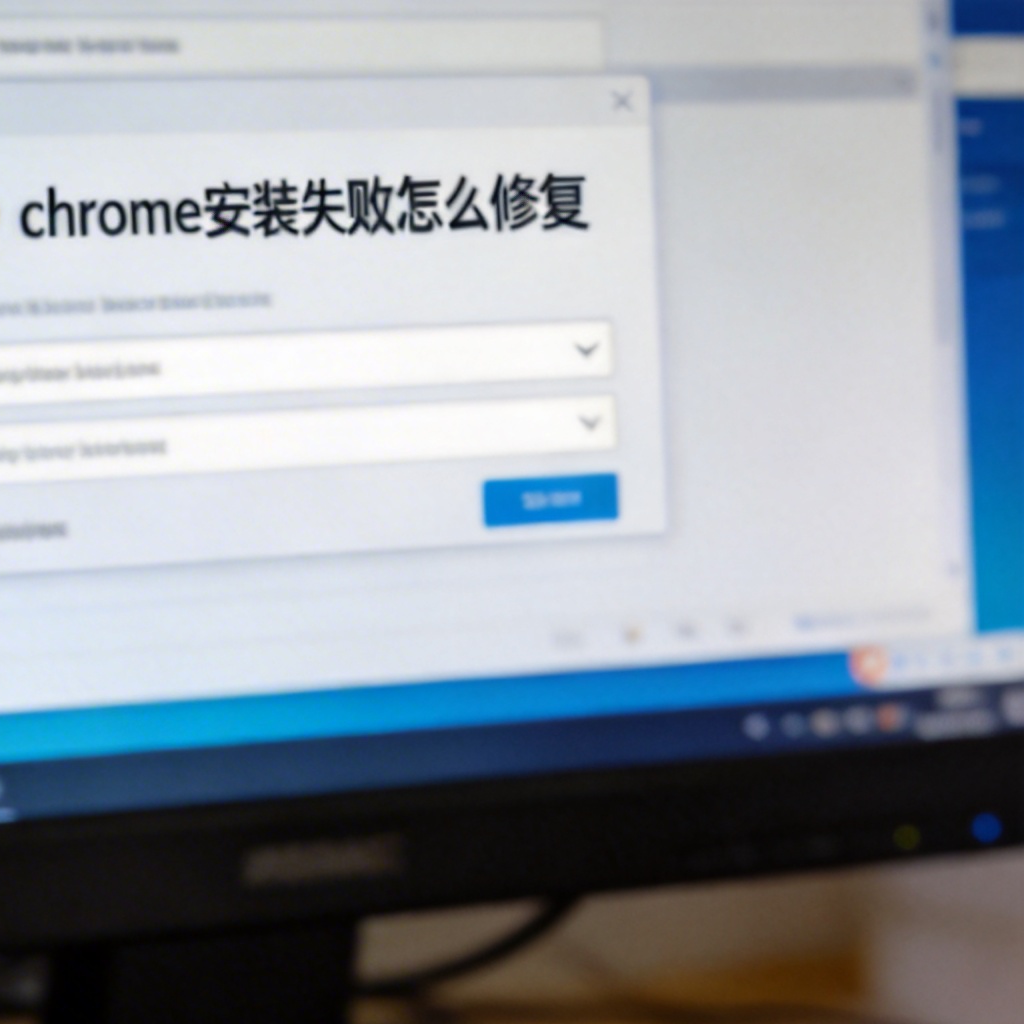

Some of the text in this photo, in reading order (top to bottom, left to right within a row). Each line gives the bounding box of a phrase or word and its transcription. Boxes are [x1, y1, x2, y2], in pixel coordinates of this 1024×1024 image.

[20, 173, 589, 238] chrome安装失败怎么修复
